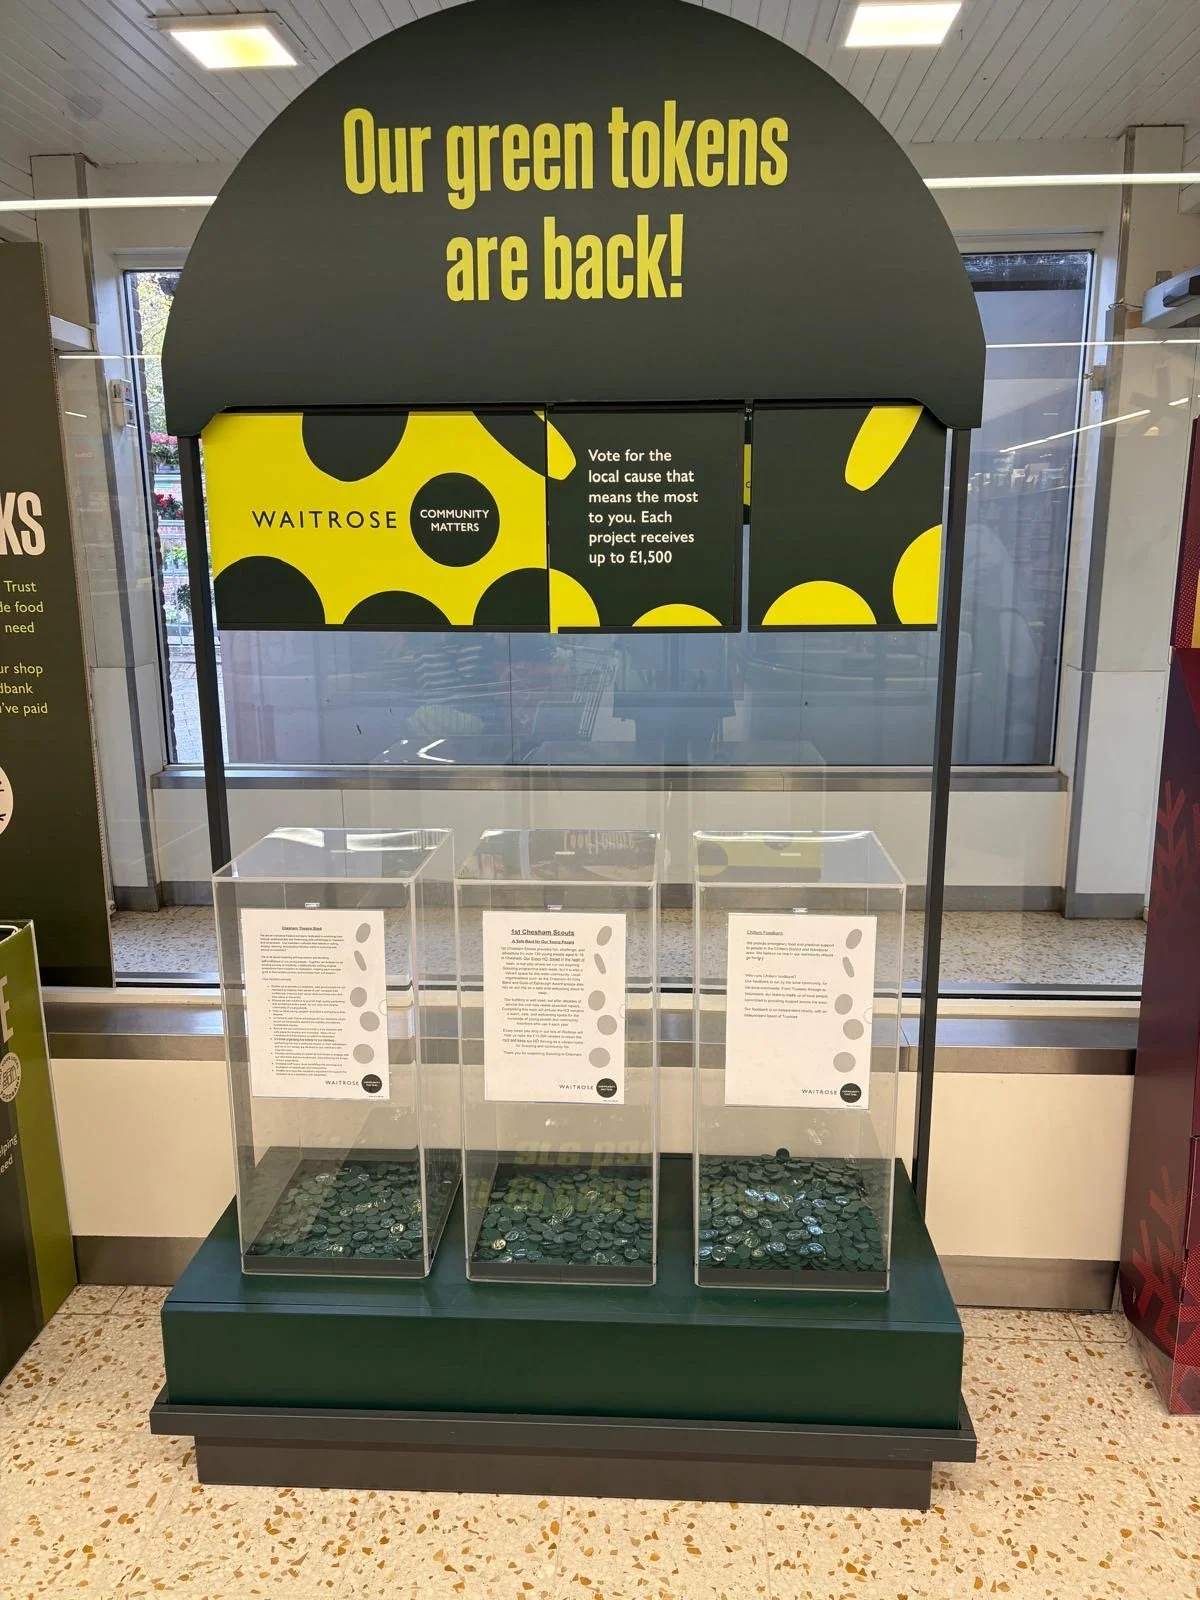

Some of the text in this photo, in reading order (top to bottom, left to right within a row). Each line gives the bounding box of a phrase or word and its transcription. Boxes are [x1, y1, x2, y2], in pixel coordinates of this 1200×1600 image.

[343, 100, 789, 210] Our green tokens
[446, 213, 684, 302] are back!
[588, 448, 672, 462] Vote for the
[588, 469, 695, 483] local cause that
[588, 490, 699, 503] means the most
[252, 510, 397, 529] WAITROSE
[419, 509, 490, 520] COMMUNITY
[588, 510, 673, 527] to you. Each
[0, 491, 46, 556] KS
[431, 522, 480, 532] MATTERS
[589, 531, 695, 547] project receives
[589, 550, 673, 567] up to £1,500
[3, 580, 37, 593] Trust
[15, 600, 44, 613] food
[4, 621, 35, 633] need
[13, 661, 43, 677] shop
[23, 702, 48, 717] paid
